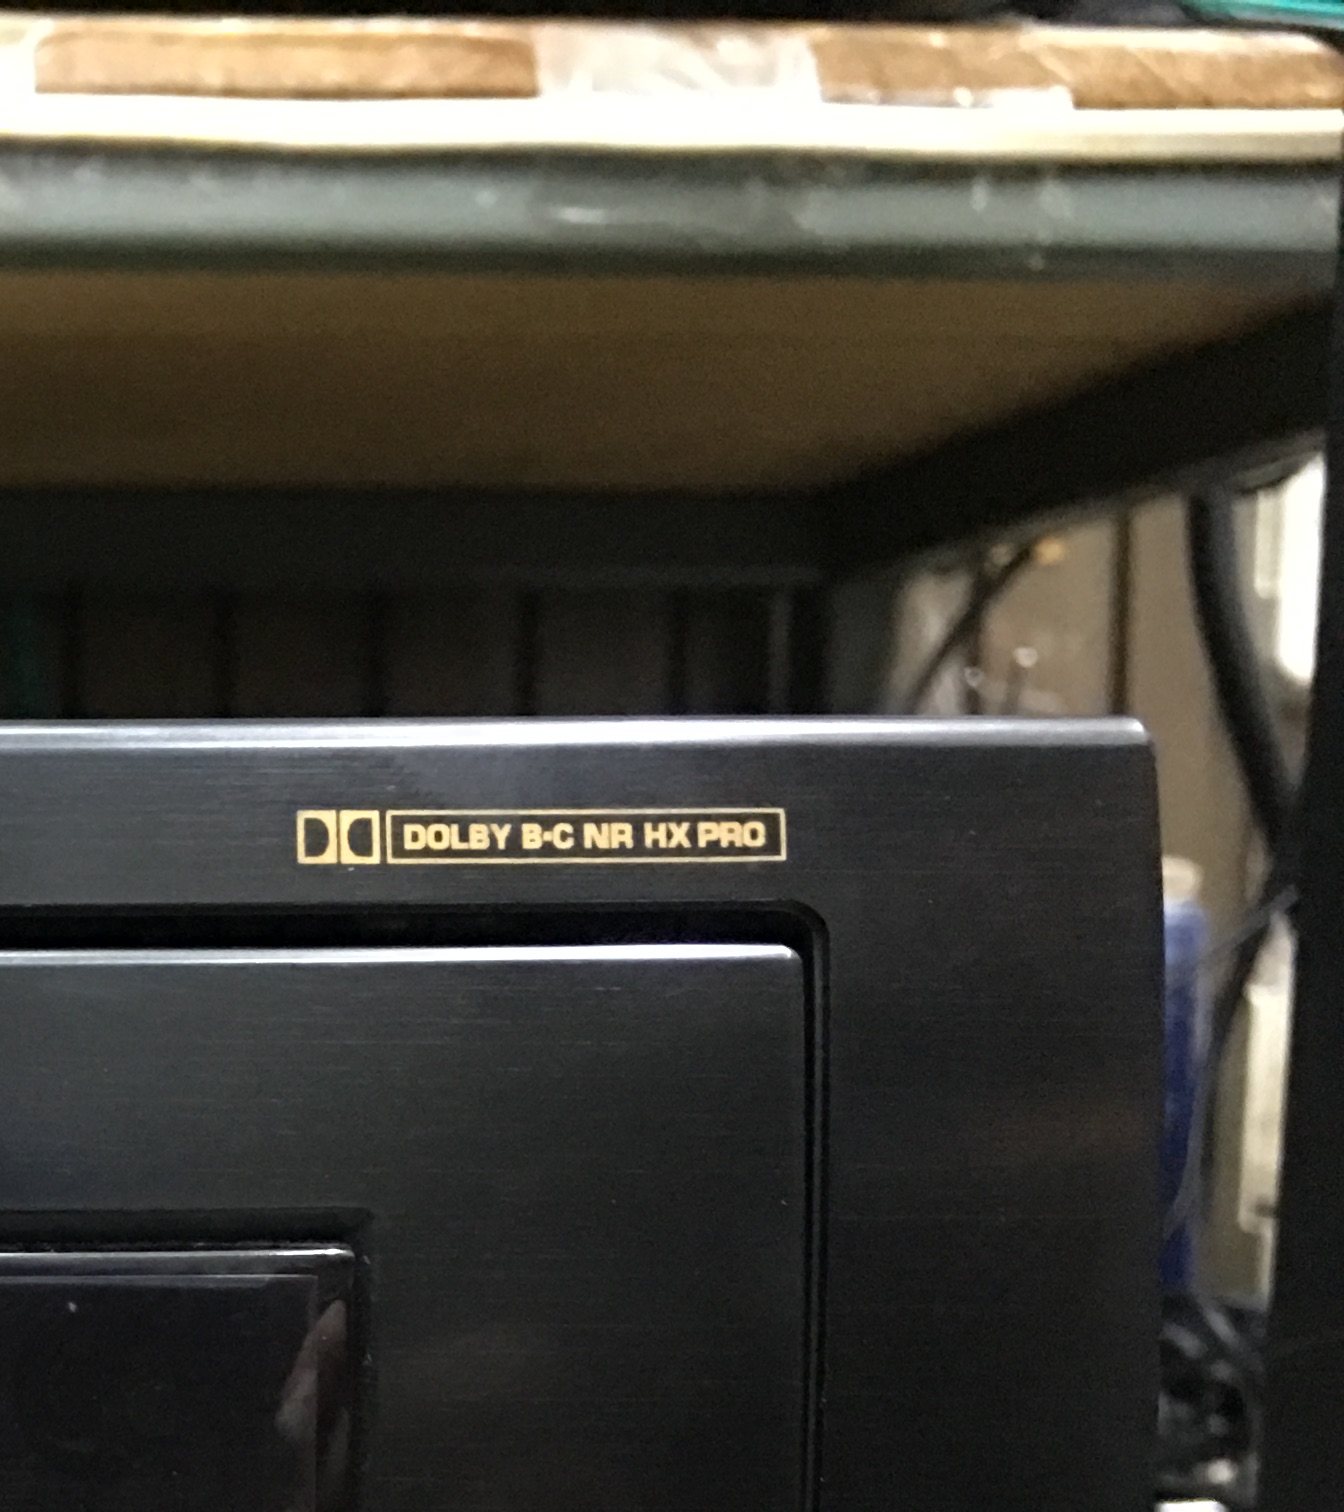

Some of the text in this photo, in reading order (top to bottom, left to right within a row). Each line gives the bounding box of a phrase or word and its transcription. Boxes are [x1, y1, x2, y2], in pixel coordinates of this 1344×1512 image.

[403, 823, 512, 851] DOLBY
[583, 822, 634, 849] NR
[643, 821, 692, 849] HX
[697, 820, 766, 848] PRO
